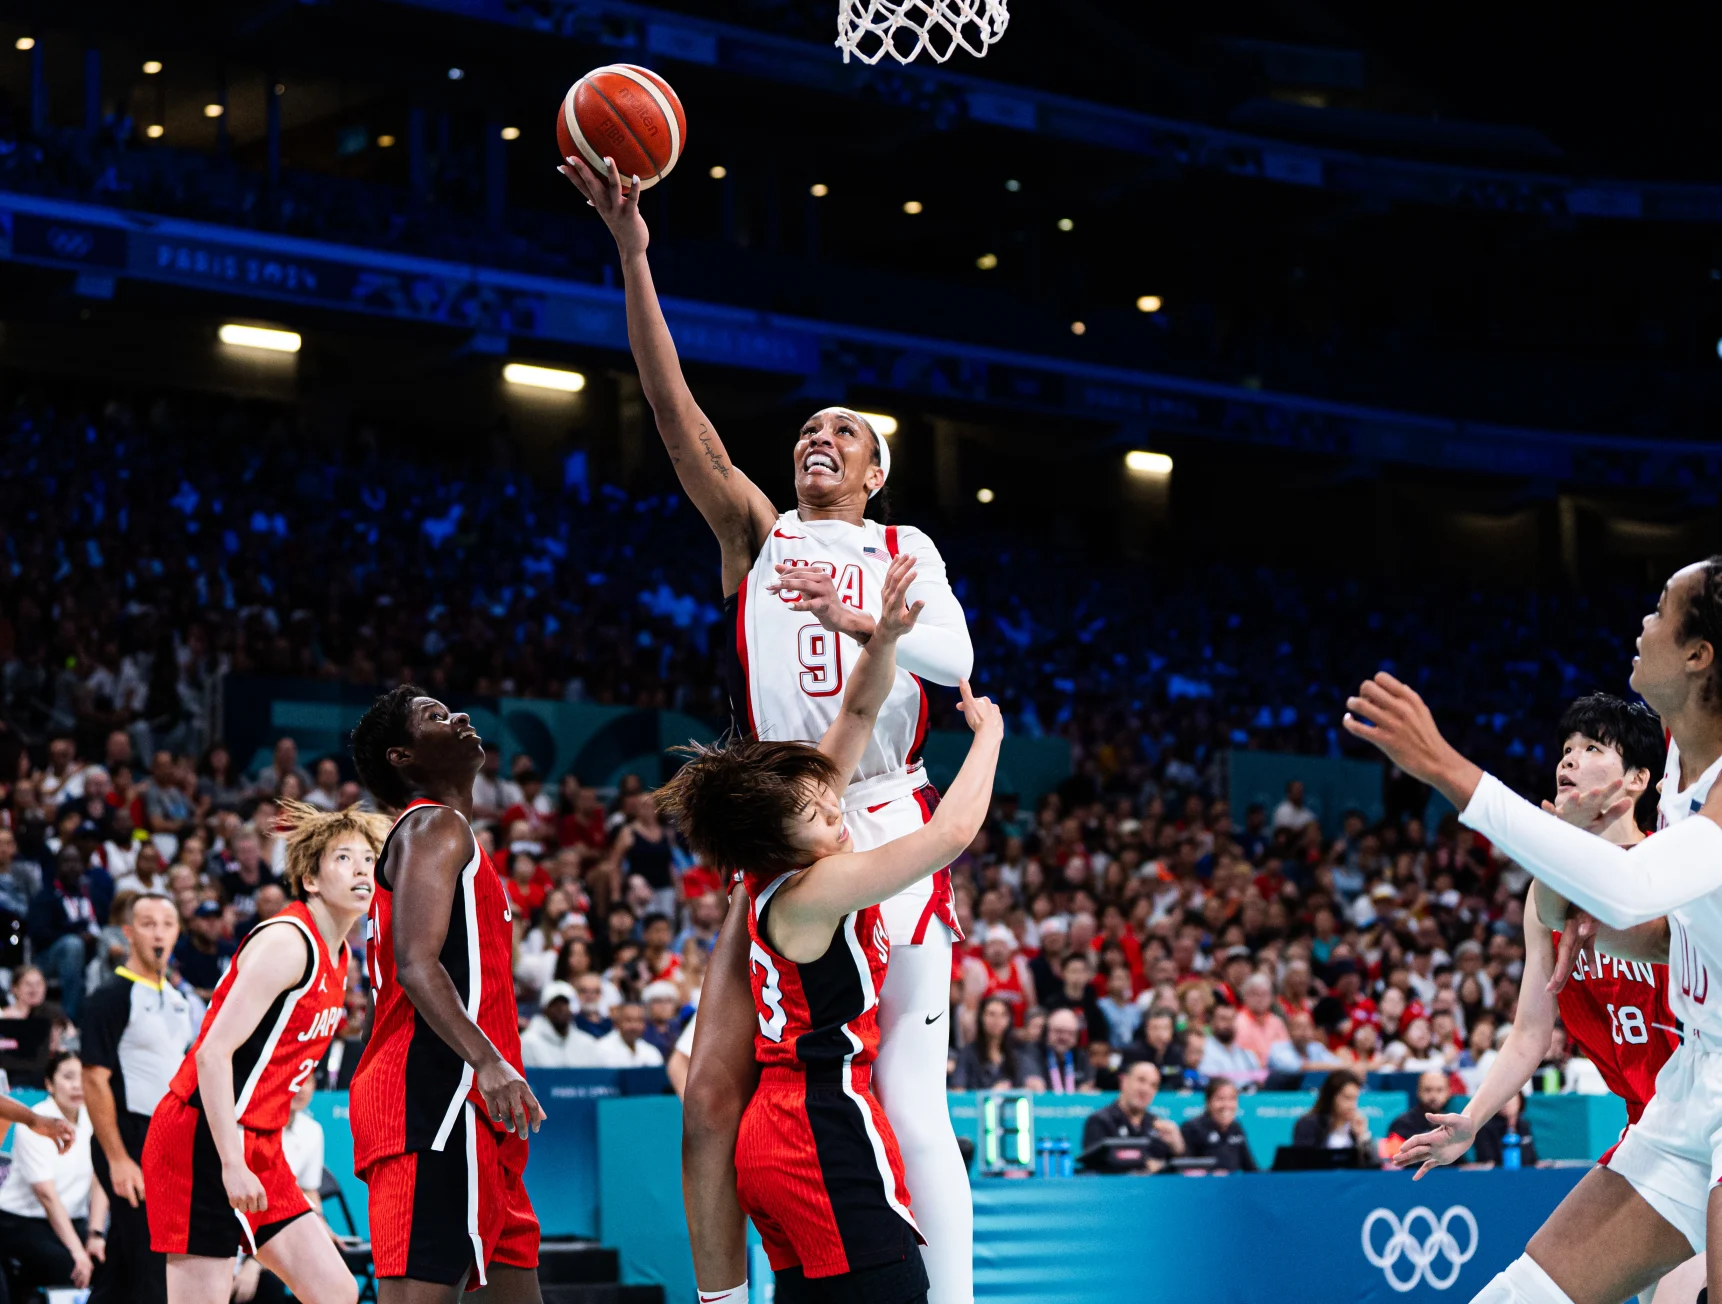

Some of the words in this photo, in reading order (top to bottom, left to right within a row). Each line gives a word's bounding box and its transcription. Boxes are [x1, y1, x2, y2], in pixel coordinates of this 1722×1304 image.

[599, 118, 625, 146] FIBA
[618, 87, 659, 137] molten
[798, 624, 842, 697] 9
